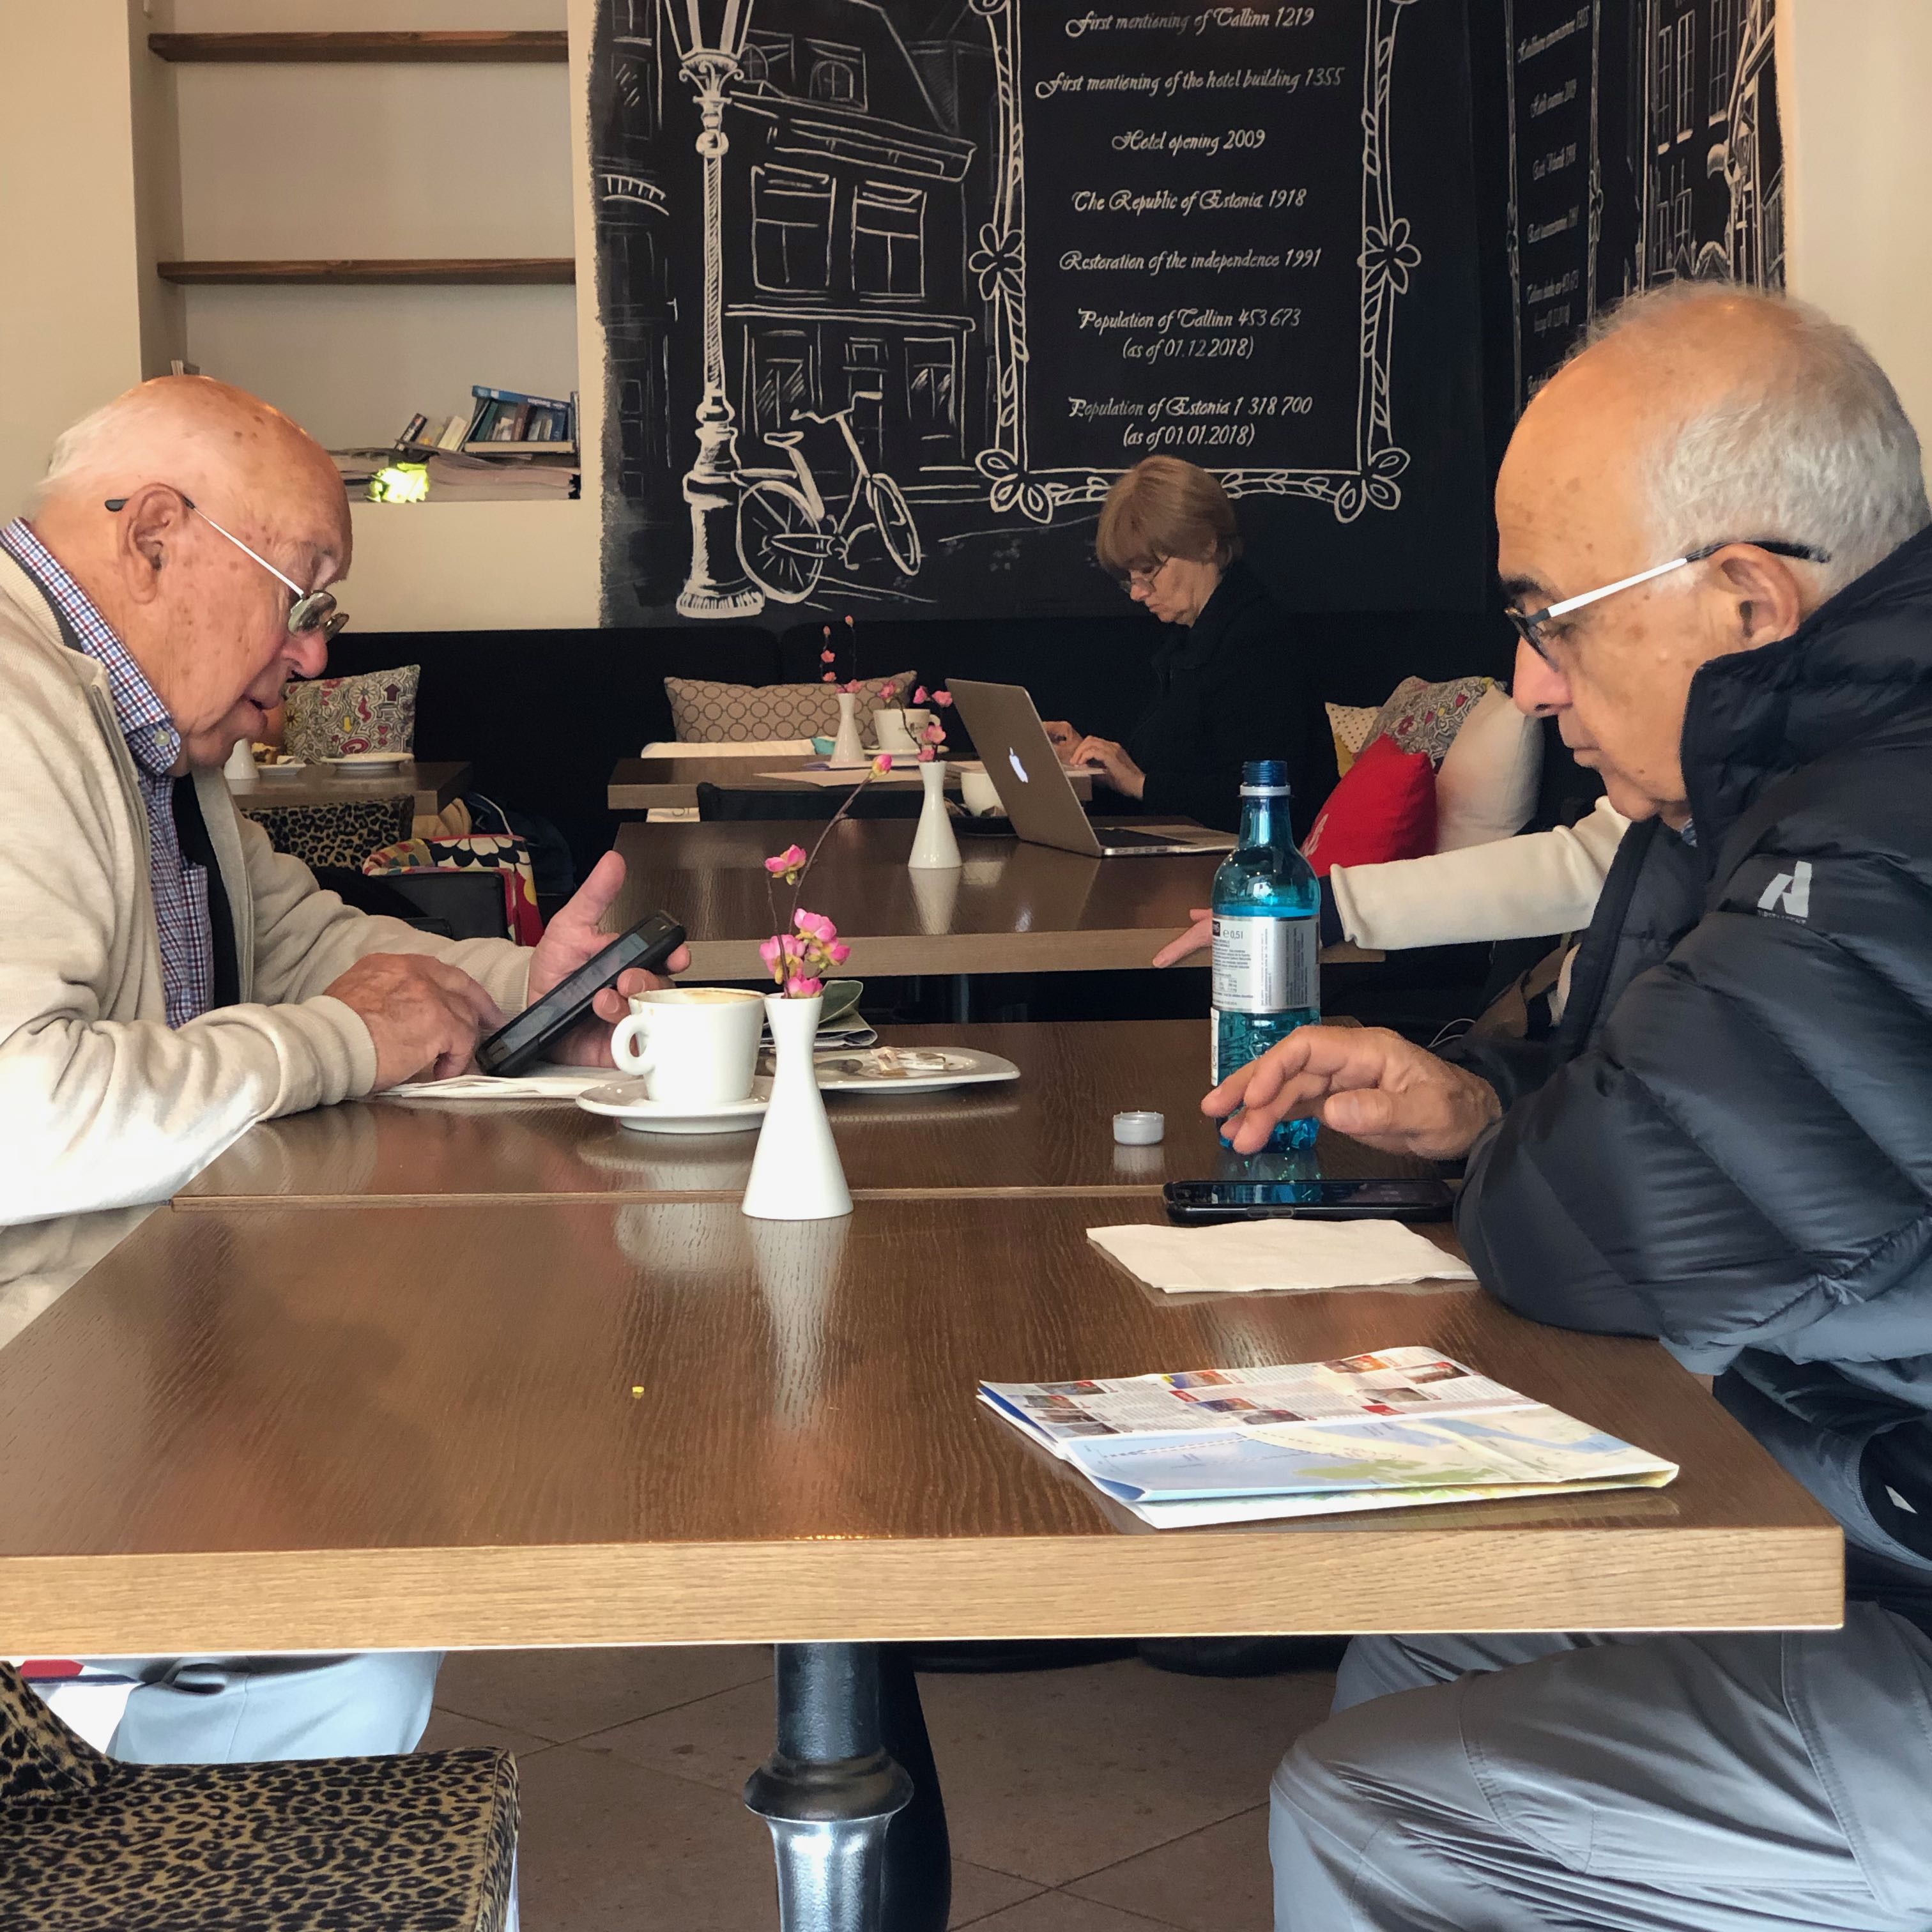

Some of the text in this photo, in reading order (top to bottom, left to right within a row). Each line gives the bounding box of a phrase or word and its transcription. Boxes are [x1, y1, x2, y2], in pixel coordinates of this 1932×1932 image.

[1065, 6, 1314, 38] First mentioning of Tallinn 1219
[1035, 67, 1345, 99] First mentioning of the hotel building 1355
[1112, 129, 1266, 157] Hotel opening 2009
[1071, 188, 1307, 216] The Republic of Estonia 1918
[1059, 248, 1321, 276] Restoration of the independence 1991
[1078, 308, 1301, 336] Population of Tallinn 453 673
[1123, 337, 1143, 358] (as
[1146, 339, 1164, 365] of
[1068, 396, 1312, 422] Population of Estonia 1 318 700
[1123, 423, 1255, 452] (as of 01.01.2018)
